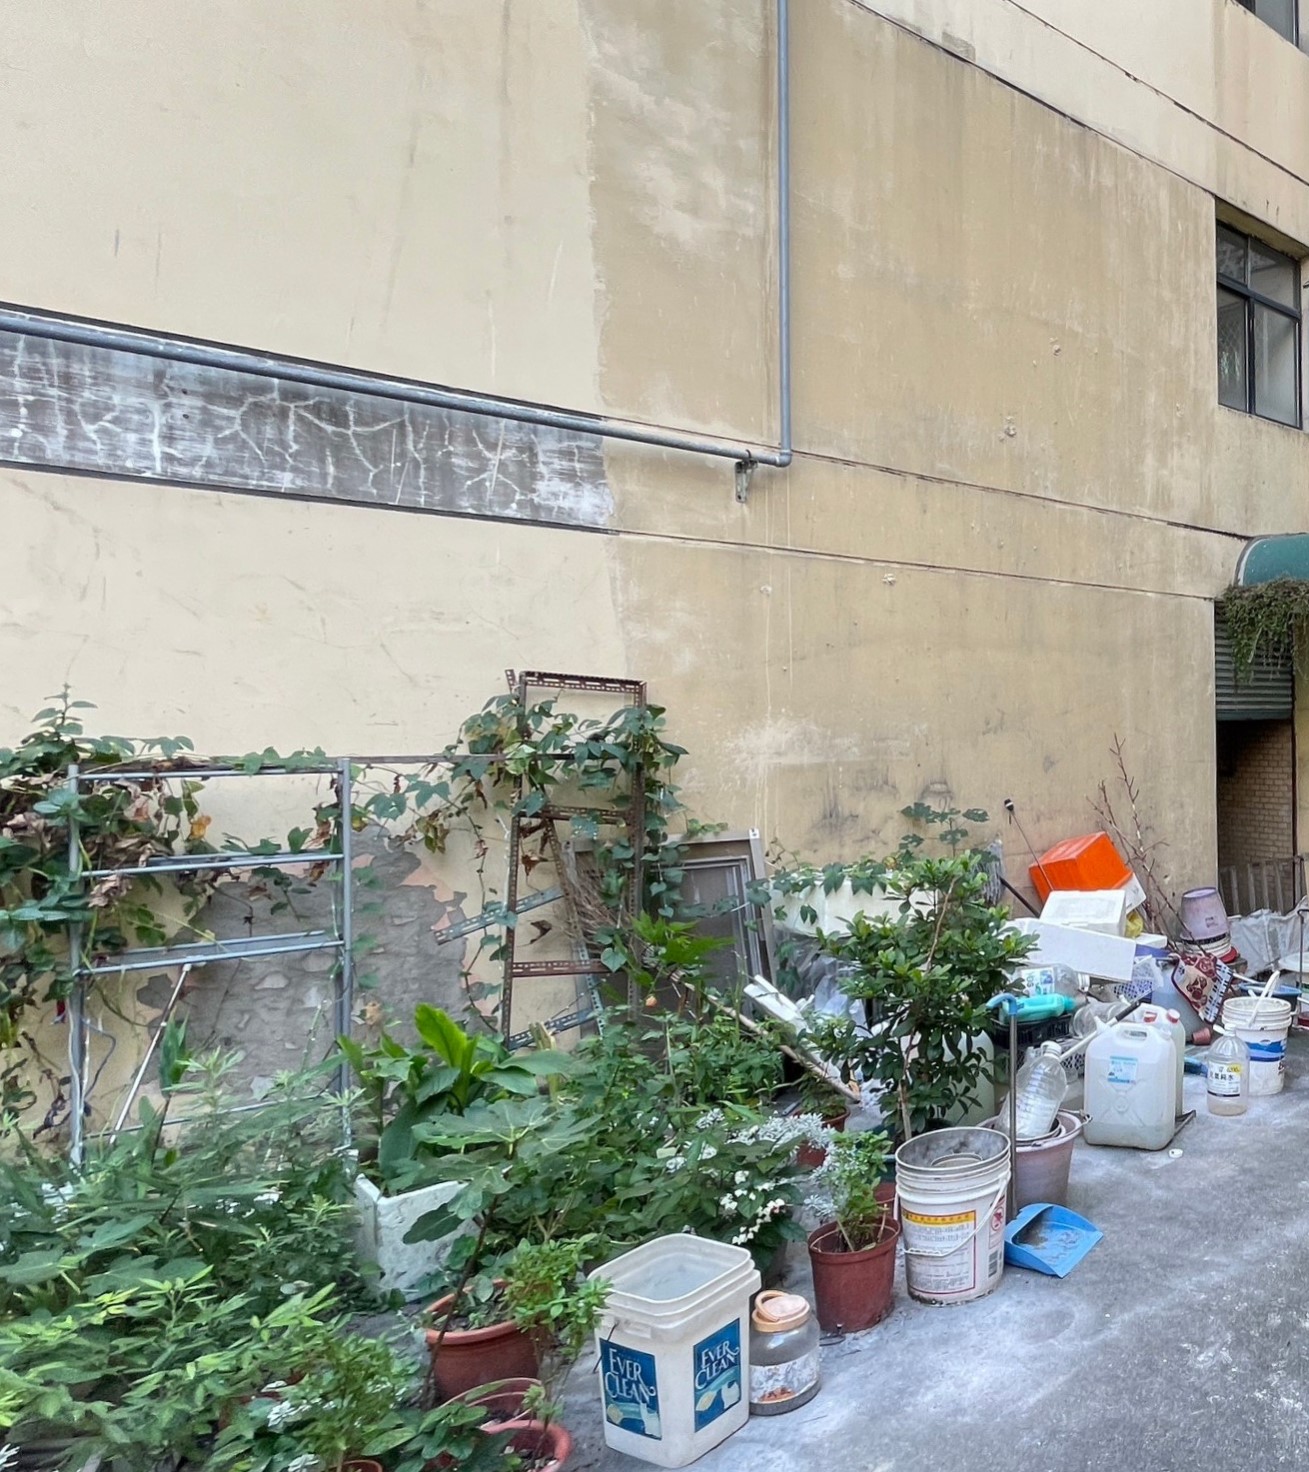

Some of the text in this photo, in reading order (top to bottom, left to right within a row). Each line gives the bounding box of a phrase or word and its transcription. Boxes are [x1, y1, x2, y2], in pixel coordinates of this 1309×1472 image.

[702, 1341, 739, 1368] EVER
[605, 1371, 650, 1403] CLEAN
[695, 1354, 735, 1389] CLEAN
